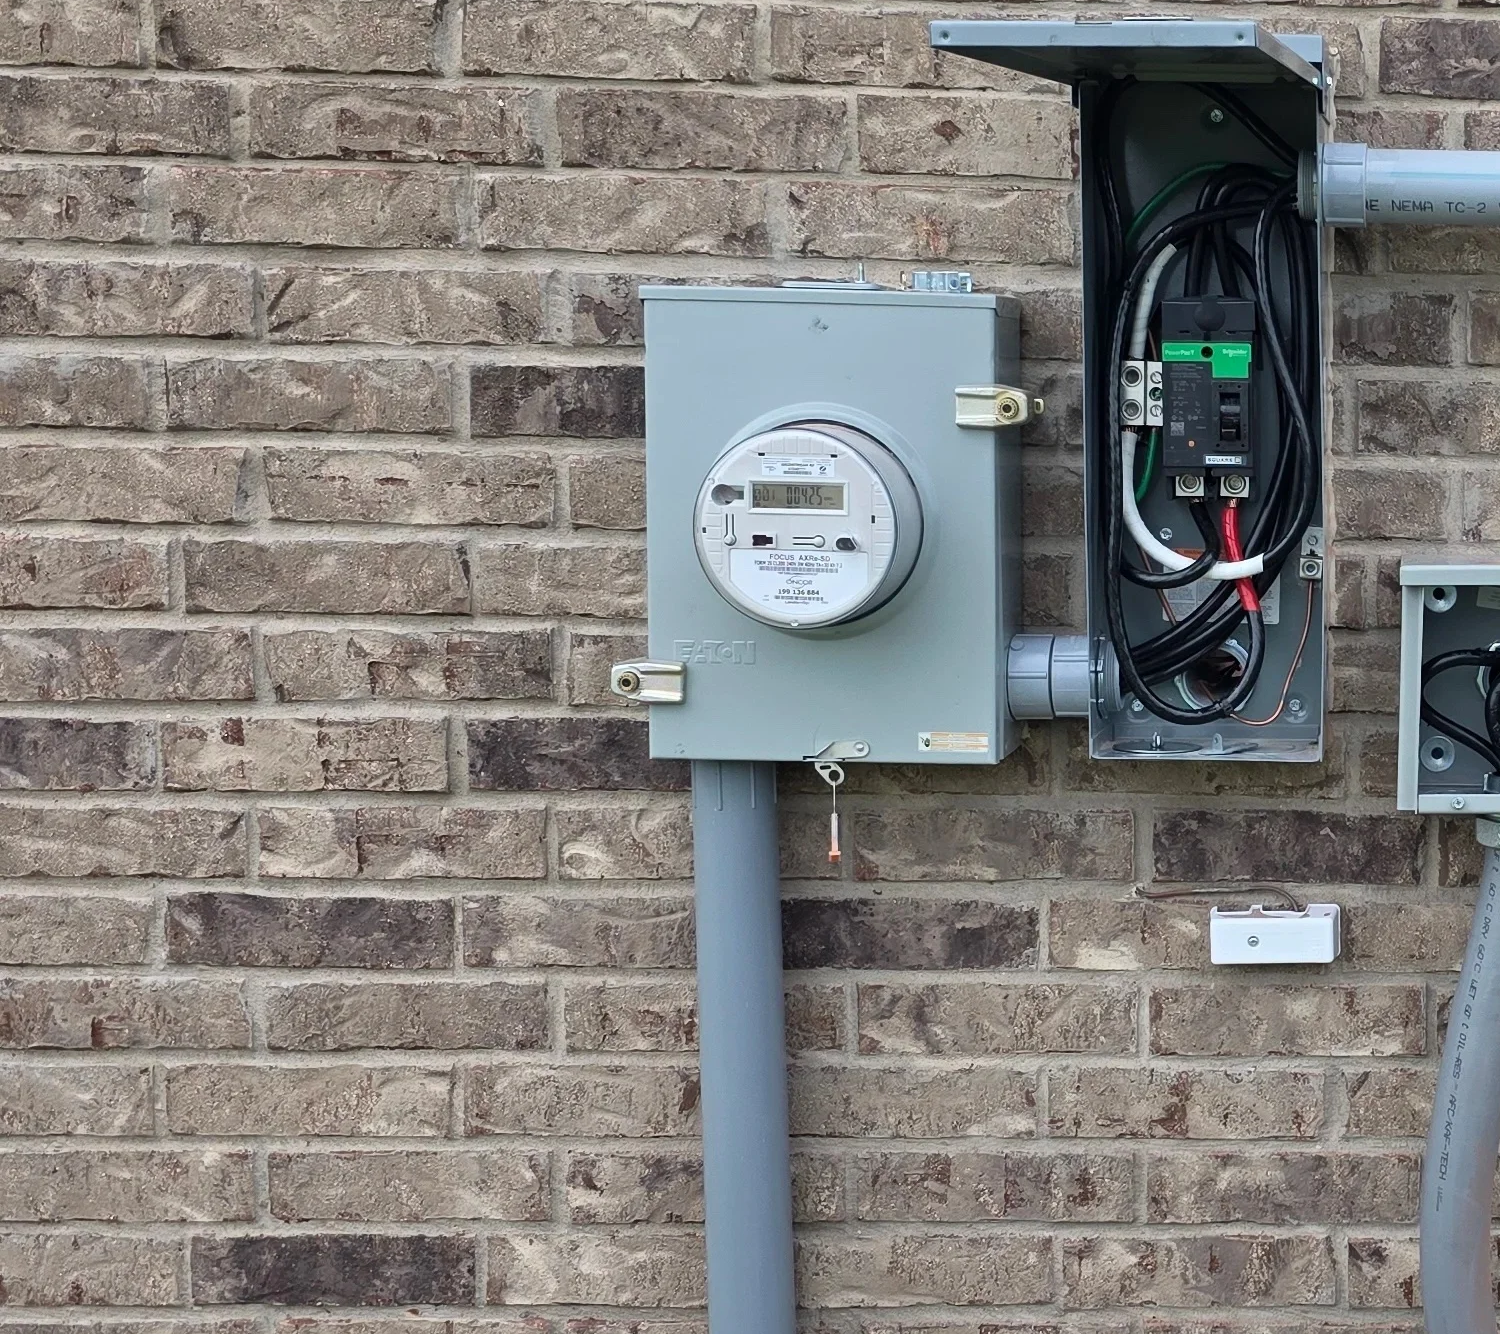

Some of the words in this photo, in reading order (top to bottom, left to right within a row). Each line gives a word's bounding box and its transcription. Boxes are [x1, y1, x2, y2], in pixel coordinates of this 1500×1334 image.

[1391, 199, 1434, 213] NEMA
[1444, 201, 1487, 214] TC-2
[787, 487, 822, 505] 00425
[673, 640, 756, 664] EATON
[1480, 916, 1492, 940] DRY
[1467, 979, 1479, 1000] WET
[1452, 1033, 1467, 1079] OIL-RES
